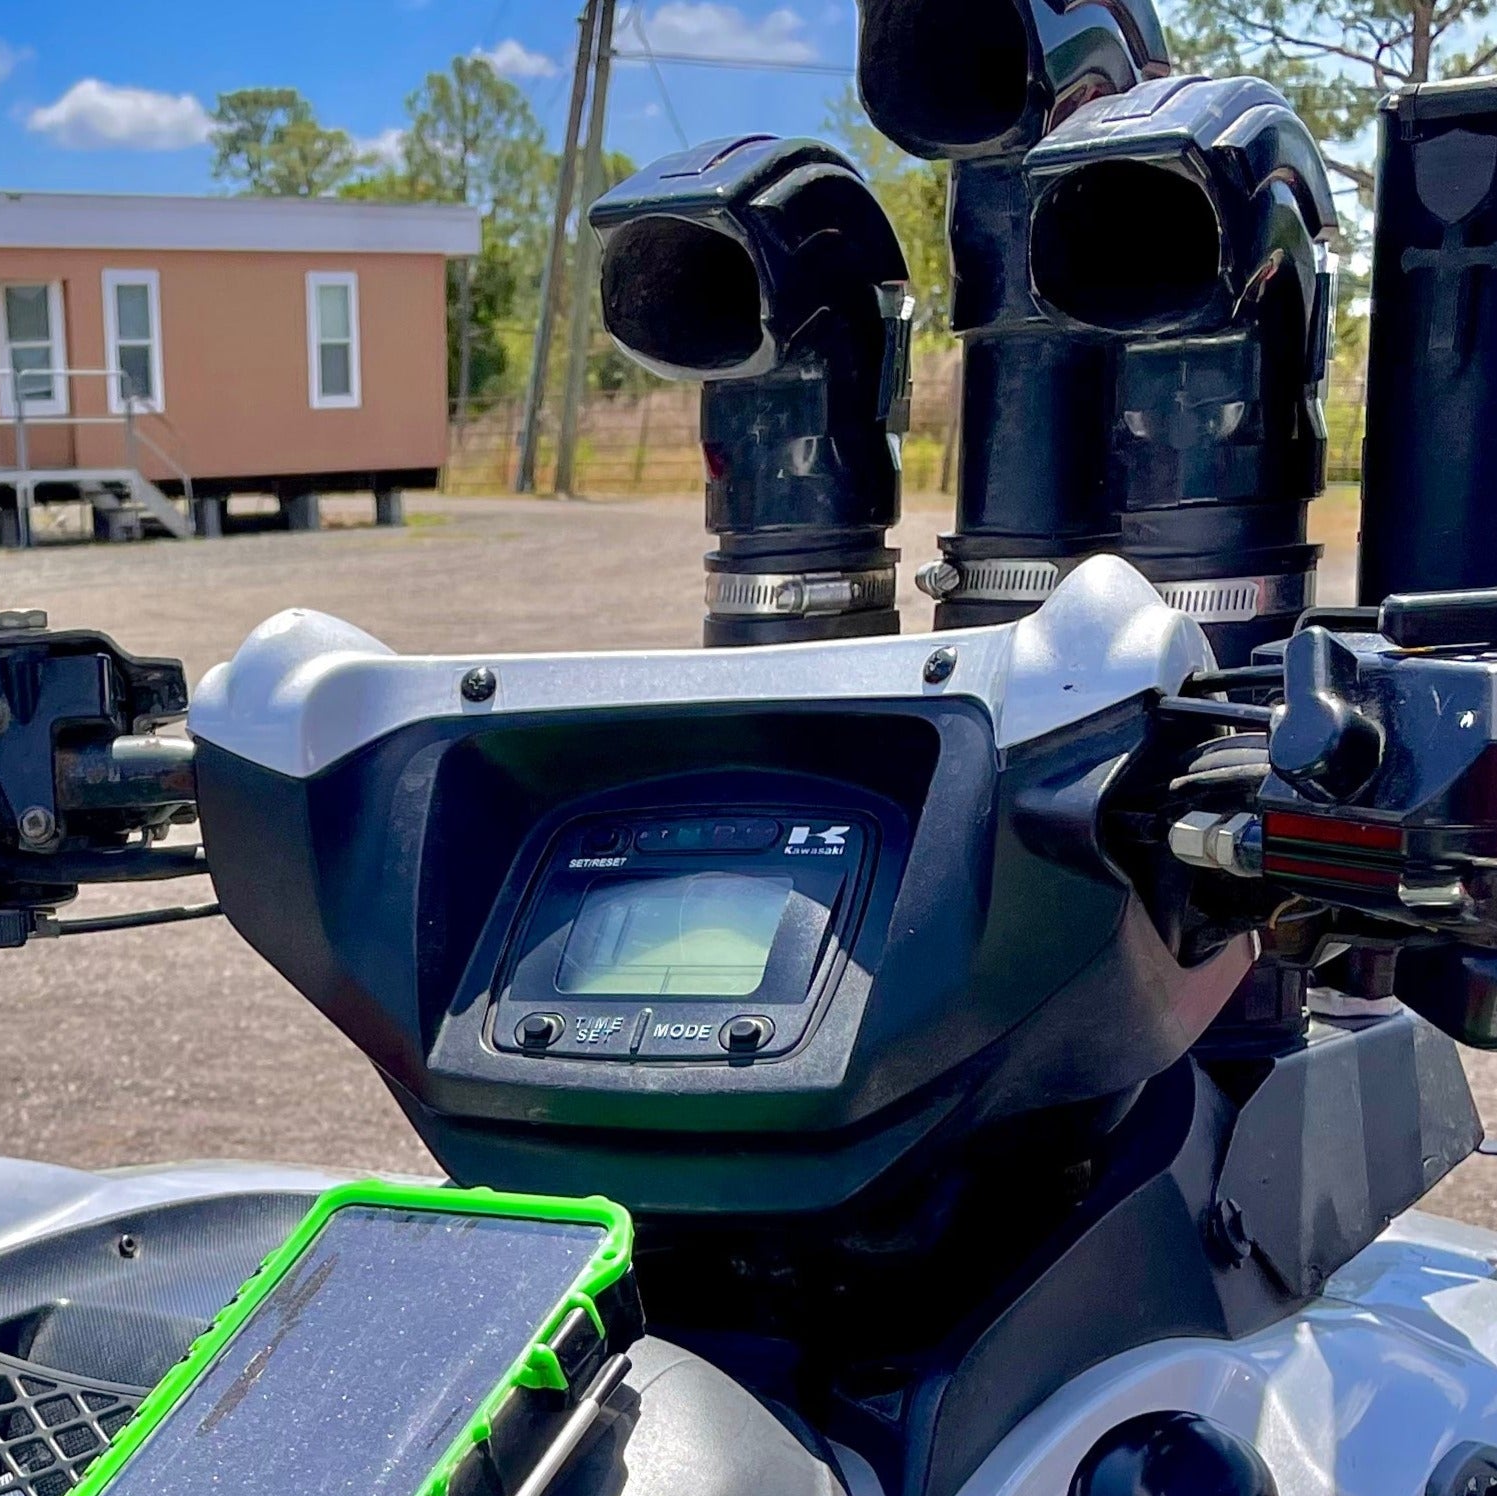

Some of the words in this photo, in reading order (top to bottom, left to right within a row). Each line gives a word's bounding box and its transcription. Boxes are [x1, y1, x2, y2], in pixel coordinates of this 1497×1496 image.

[783, 845, 845, 856] Kawasaki
[568, 856, 628, 869] SET/RESET
[575, 1016, 624, 1031] TIME
[575, 1028, 614, 1044] SET
[652, 1023, 713, 1041] MODE
